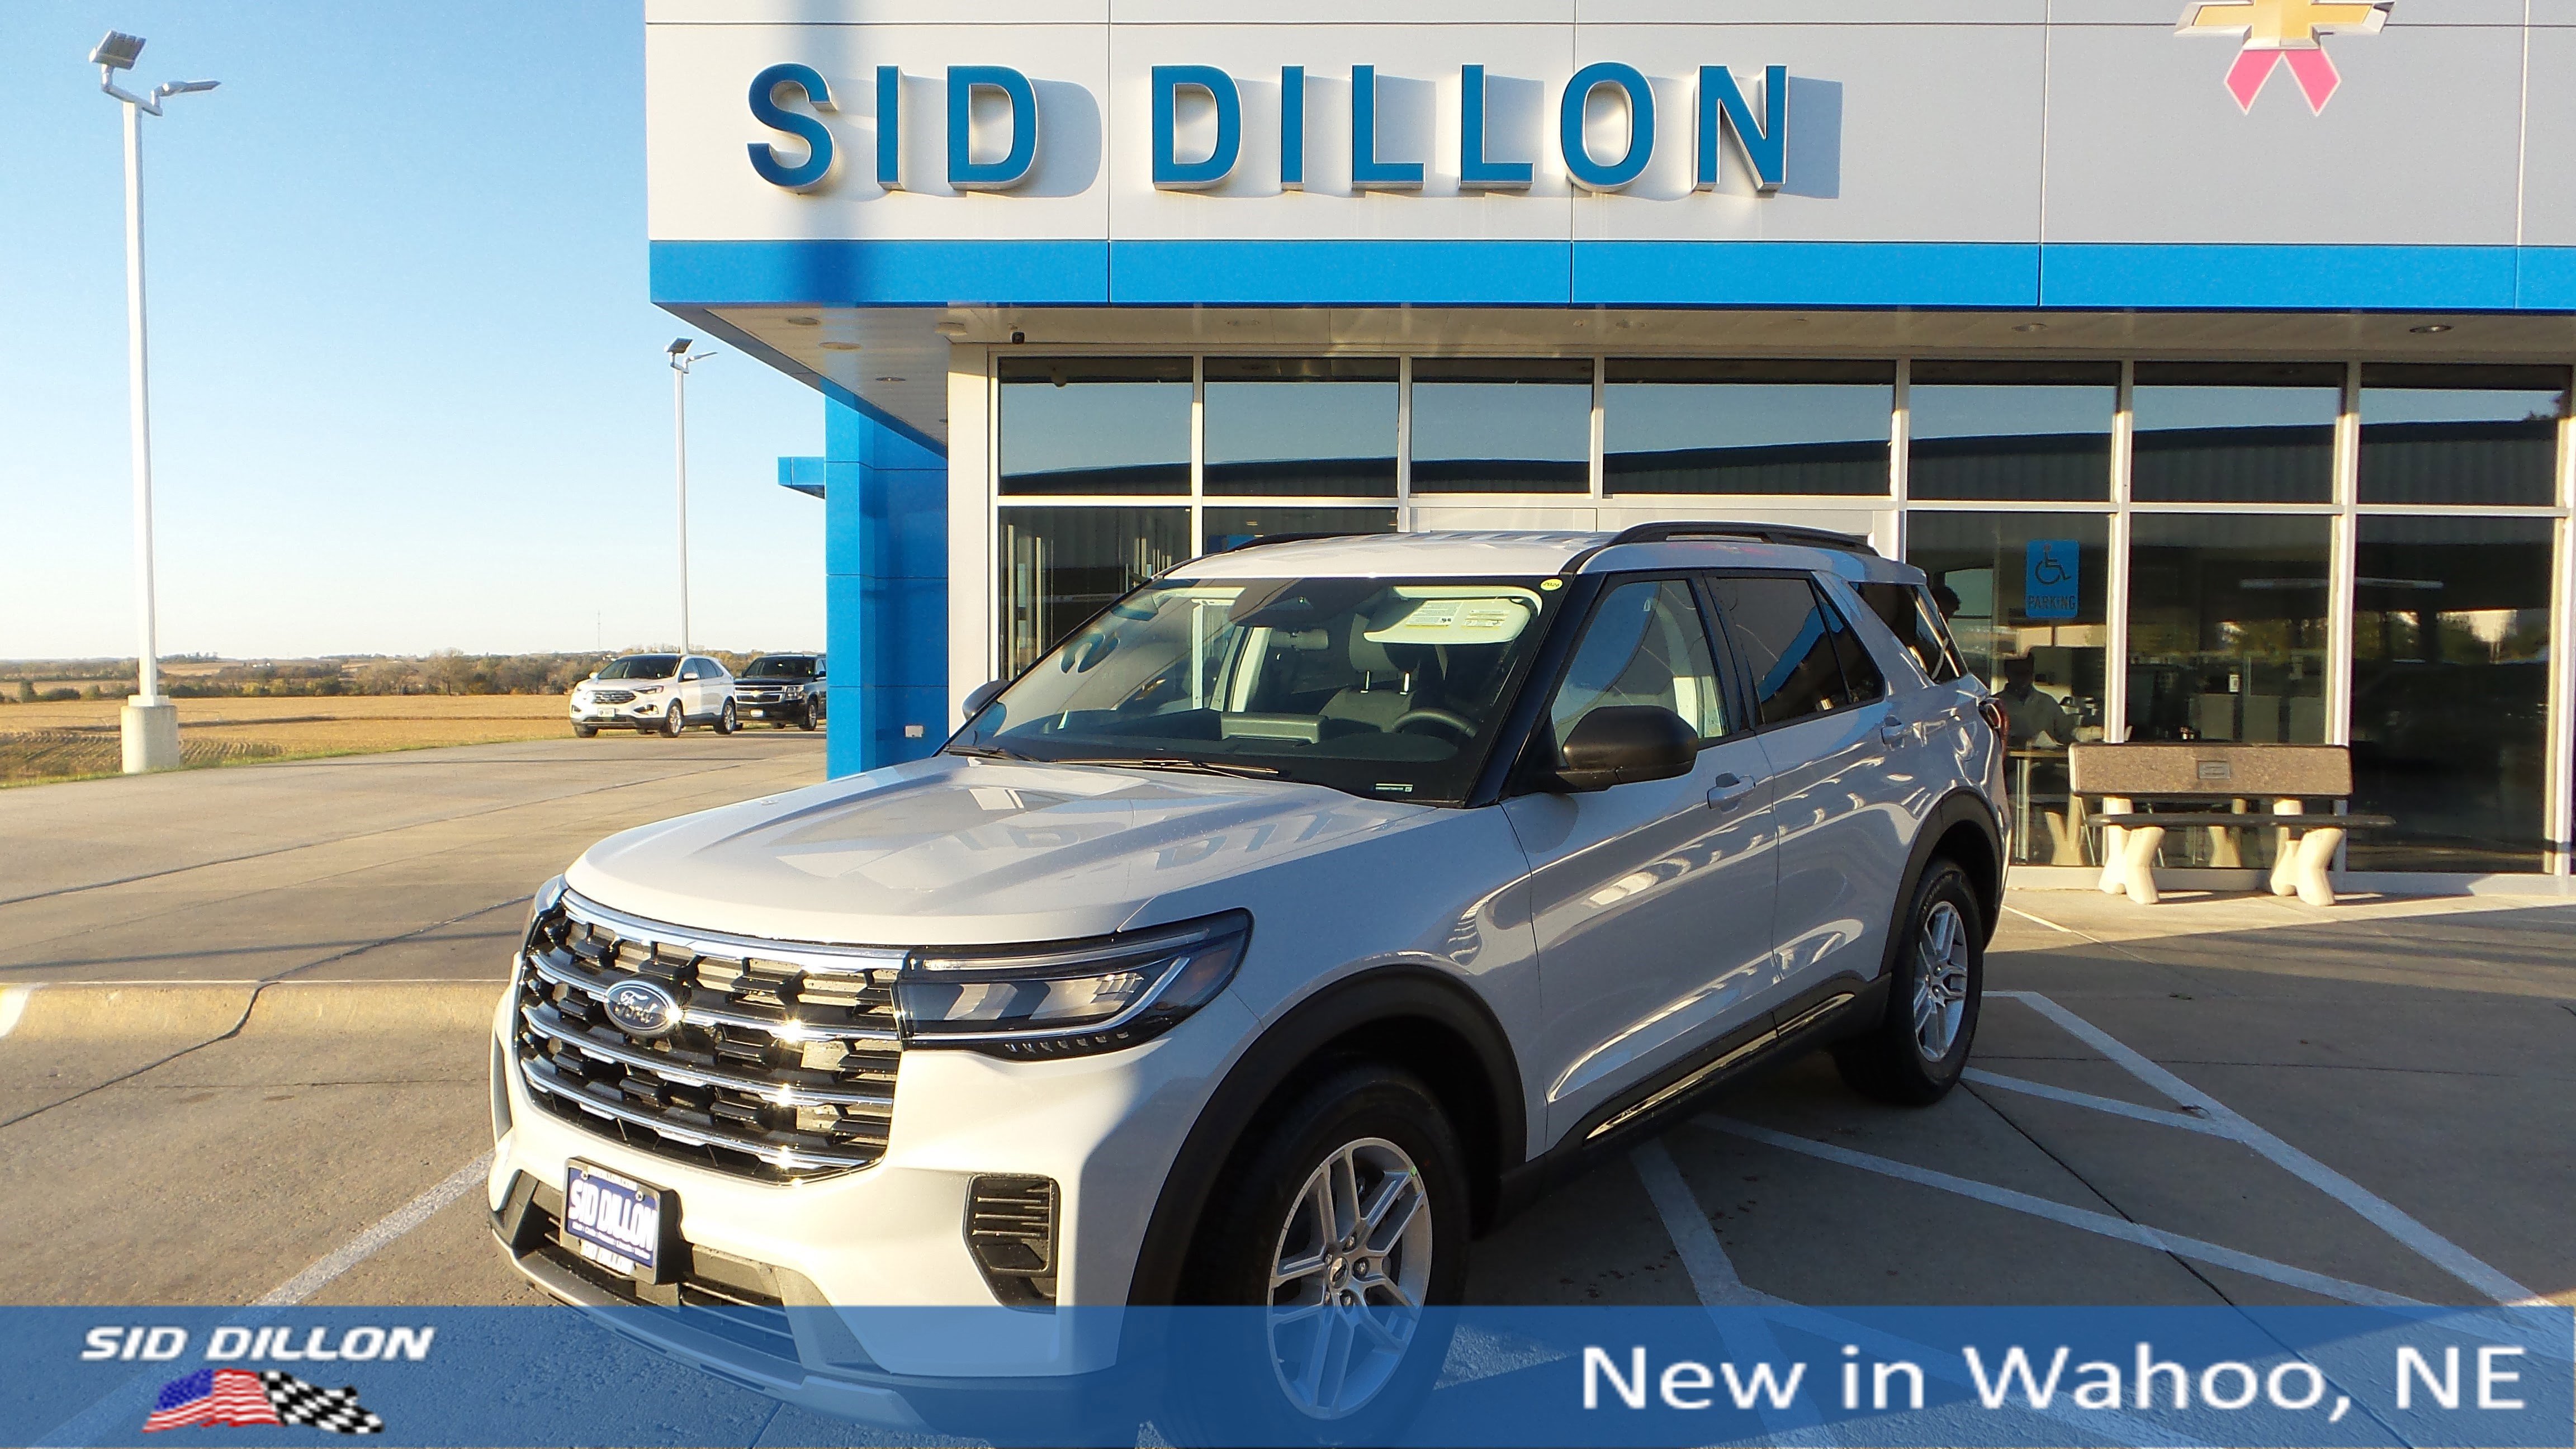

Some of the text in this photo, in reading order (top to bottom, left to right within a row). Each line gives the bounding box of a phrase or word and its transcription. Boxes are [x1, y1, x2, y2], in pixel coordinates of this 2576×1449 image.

[747, 61, 1788, 191] SID DILLON
[2028, 595, 2075, 610] PARKING
[615, 989, 659, 1024] Ford
[568, 1178, 657, 1252] SID DILLON
